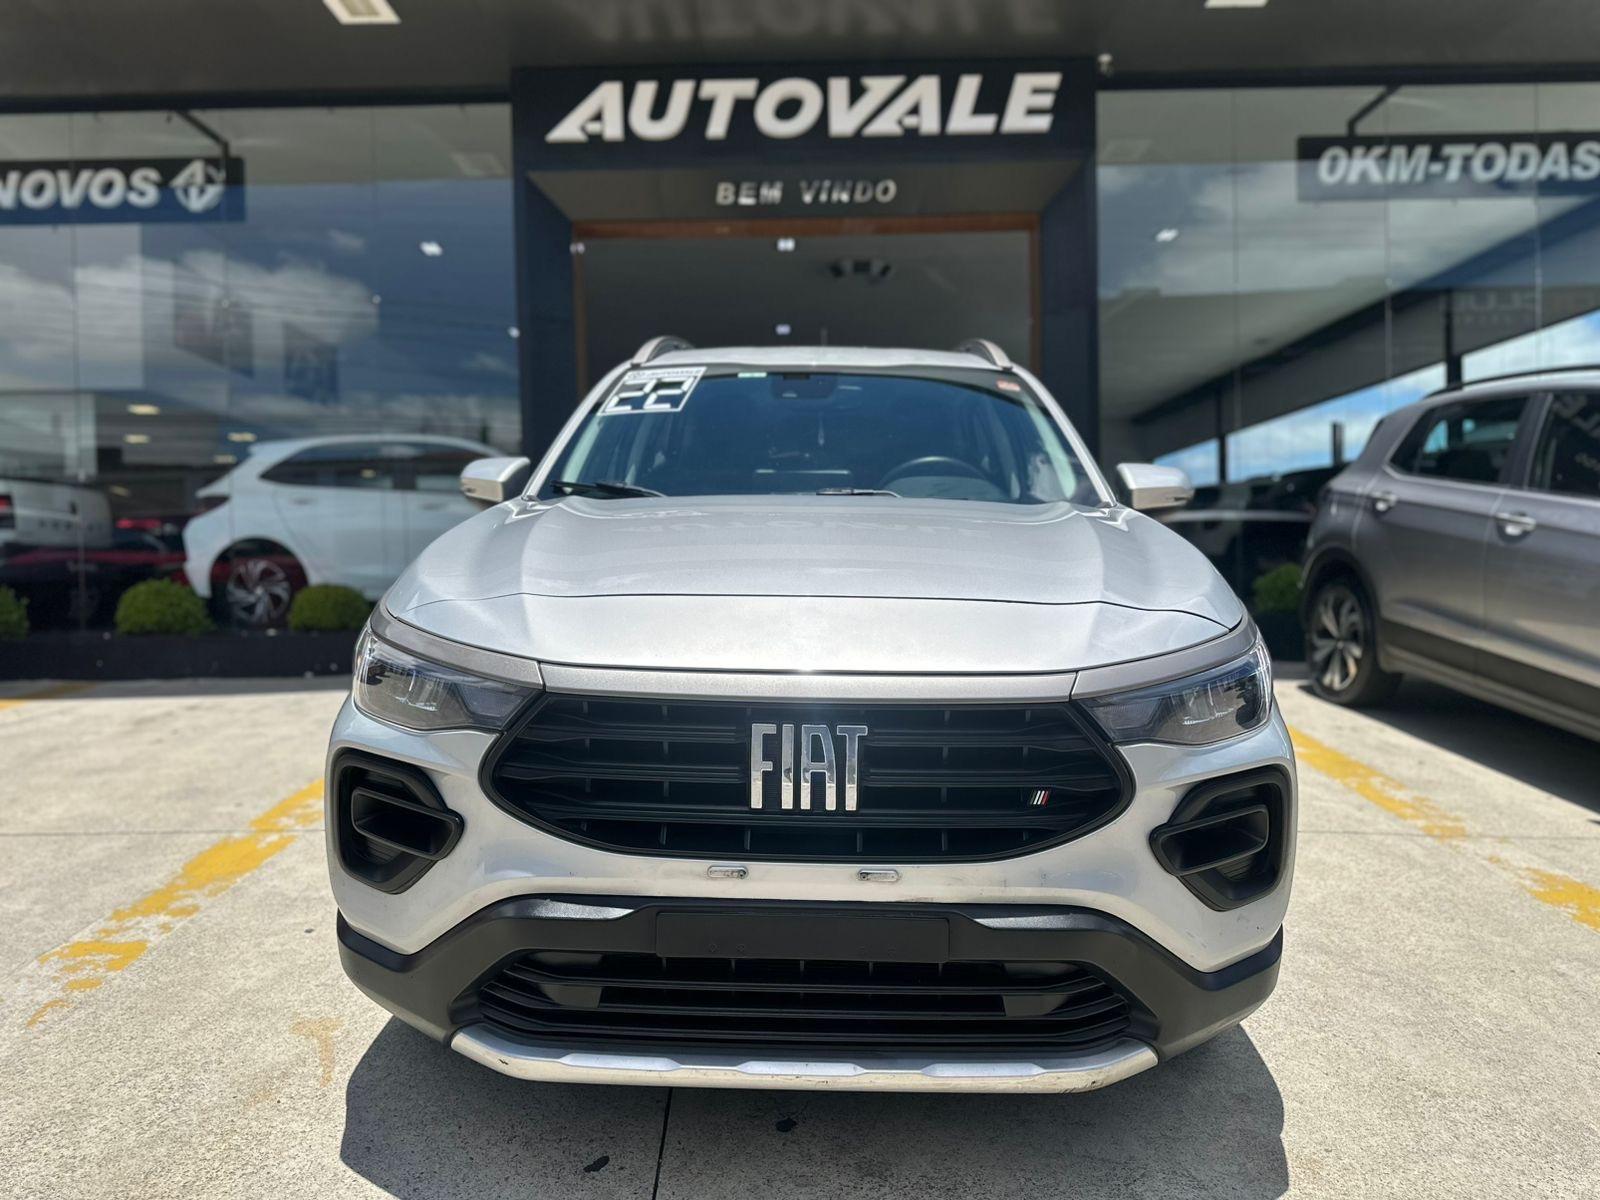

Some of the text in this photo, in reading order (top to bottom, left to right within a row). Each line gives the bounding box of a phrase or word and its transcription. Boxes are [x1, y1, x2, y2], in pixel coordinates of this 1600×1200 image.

[545, 72, 1063, 143] AUTOVALE
[715, 178, 898, 206] BEM VINDO
[604, 376, 694, 412] 22
[750, 723, 869, 811] FIAT
